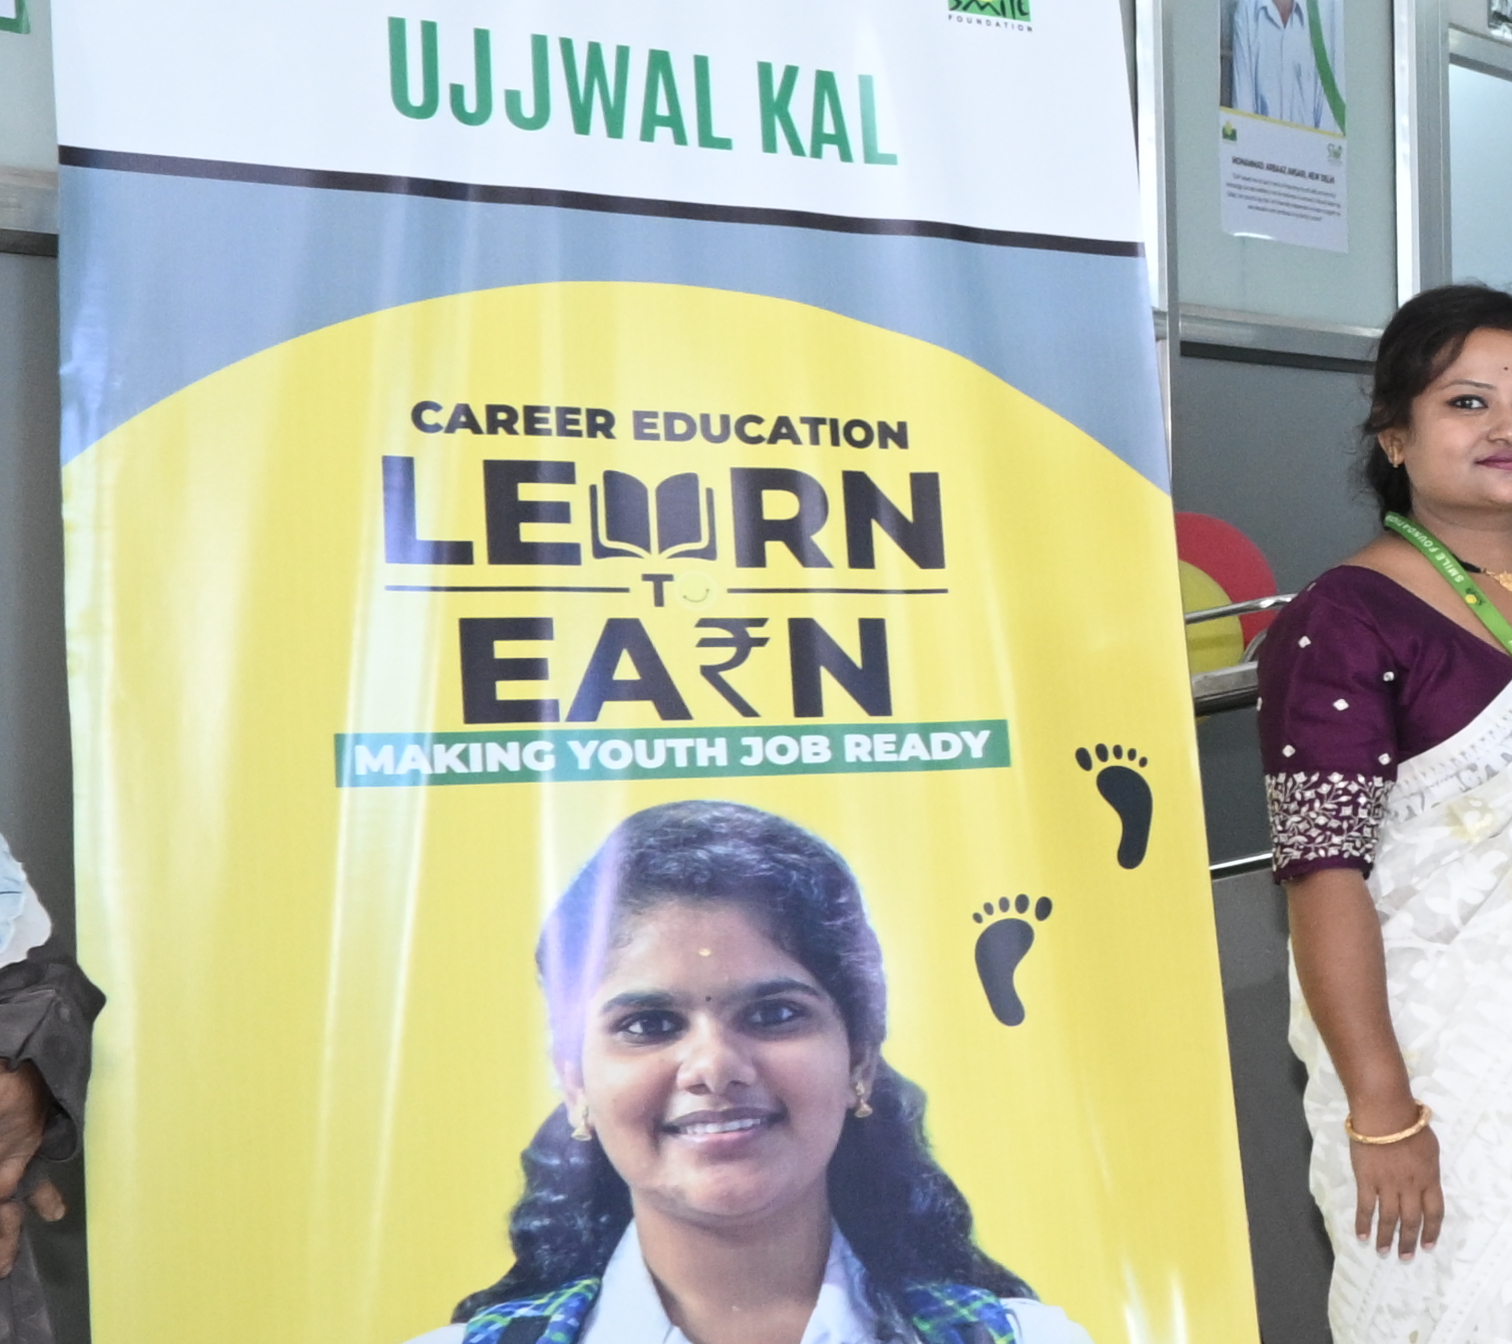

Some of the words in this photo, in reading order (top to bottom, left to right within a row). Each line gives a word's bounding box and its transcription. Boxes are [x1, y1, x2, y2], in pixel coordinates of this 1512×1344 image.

[948, 14, 1034, 33] FOUNDATION
[388, 15, 734, 154] UJJWAL
[758, 59, 900, 167] KAL
[410, 399, 619, 442] CAREER
[631, 408, 910, 452] EDUCATION
[1435, 552, 1465, 583] SMILE
[353, 738, 556, 777] MAKING
[566, 735, 729, 772] YOUTH
[738, 733, 833, 768] JOB
[843, 727, 991, 764] READY
